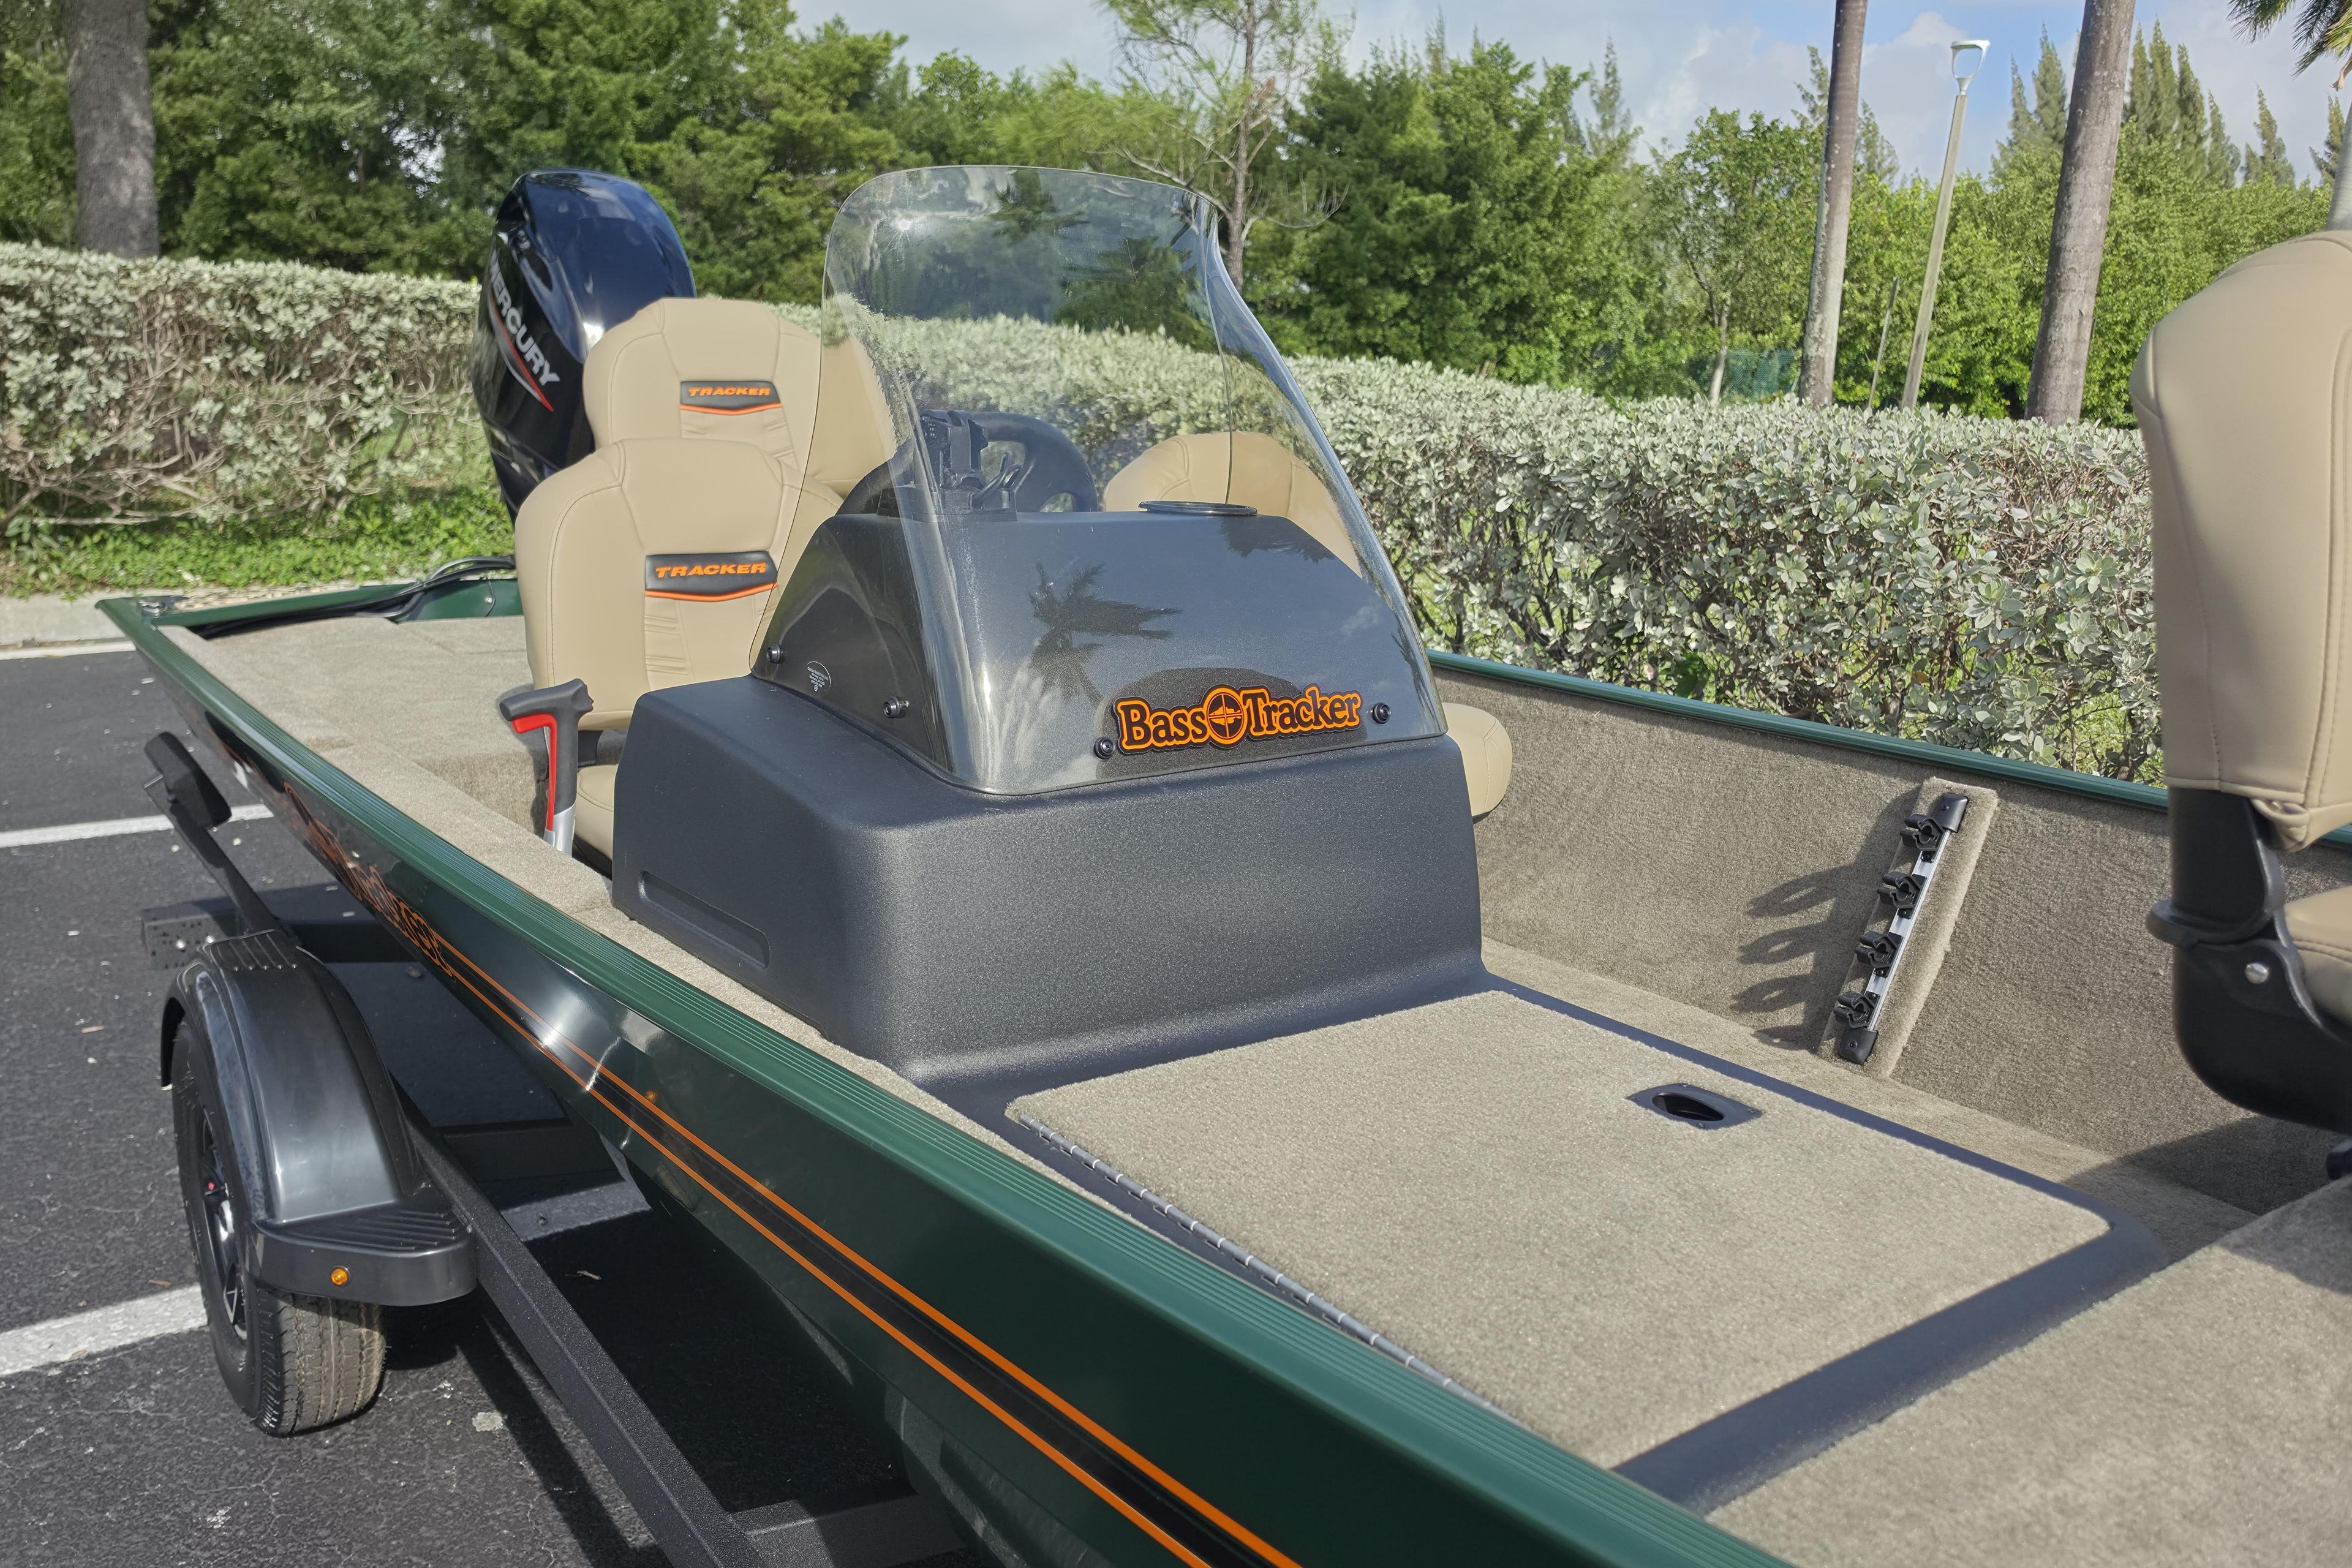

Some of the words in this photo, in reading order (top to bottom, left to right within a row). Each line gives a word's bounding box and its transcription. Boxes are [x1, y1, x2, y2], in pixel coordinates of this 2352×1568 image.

[688, 386, 771, 397] TRACKER
[655, 562, 767, 578] TRACKER
[1119, 702, 1208, 748] Bass
[1242, 687, 1361, 735] Tracker
